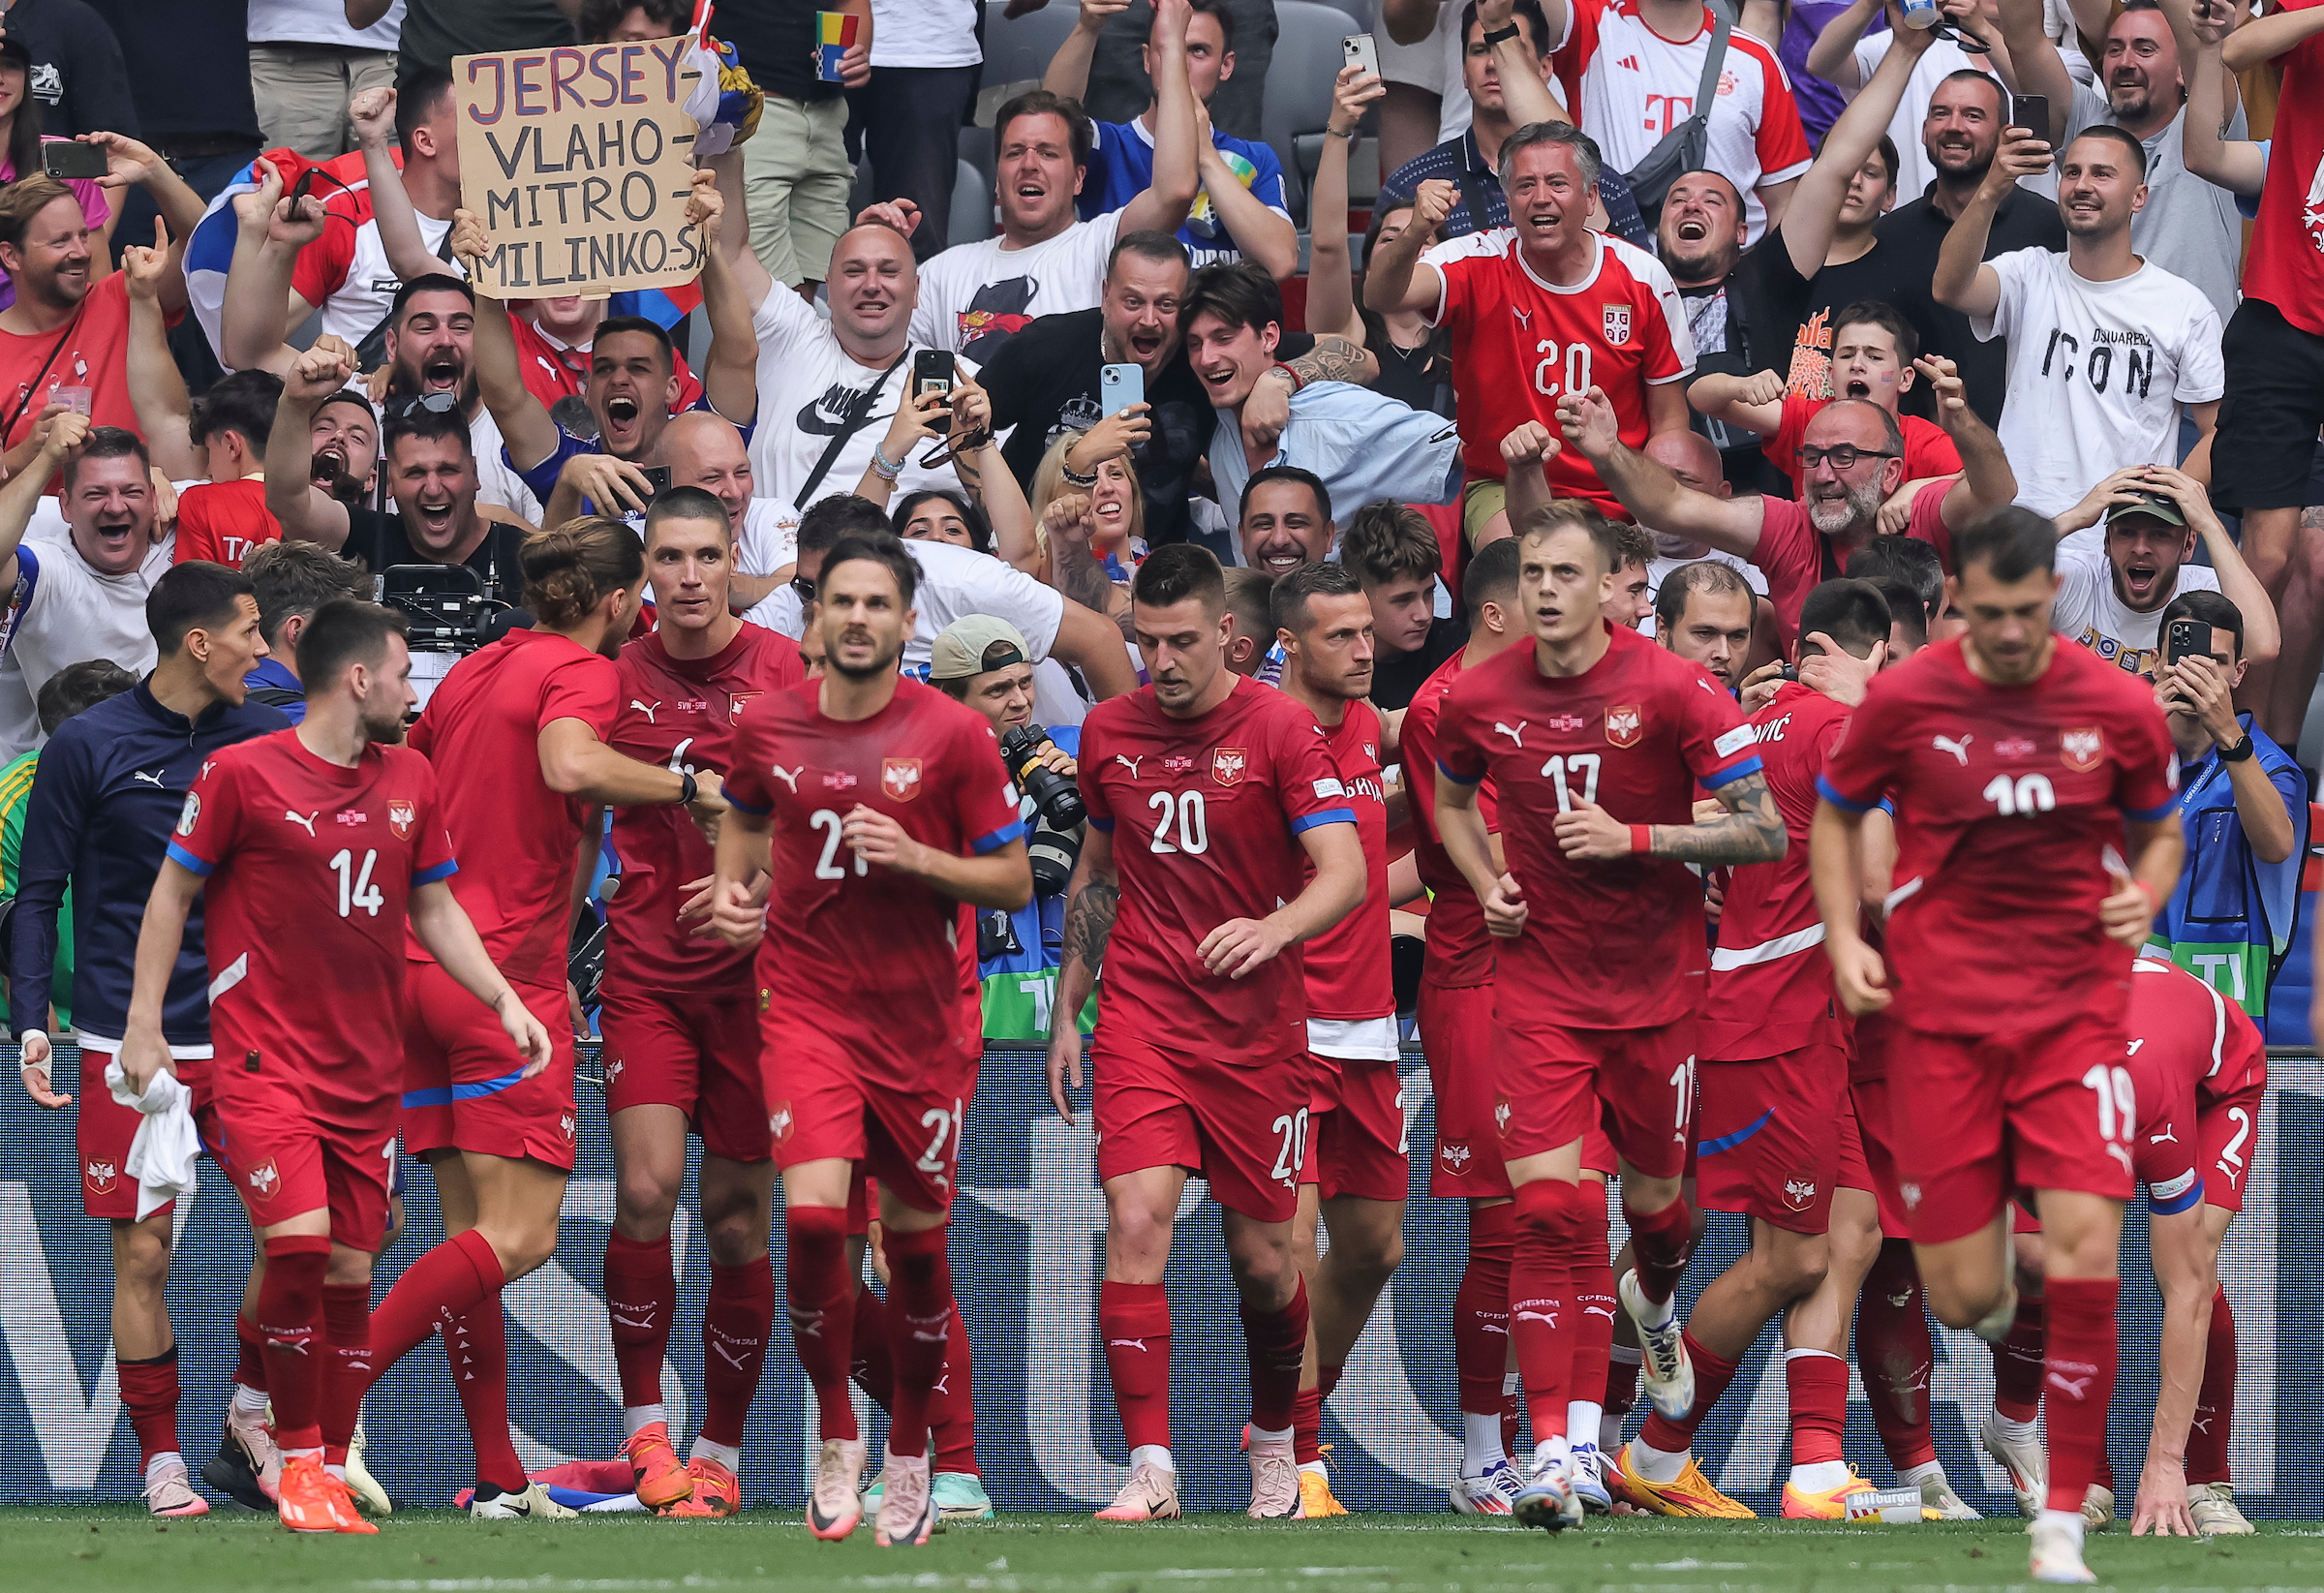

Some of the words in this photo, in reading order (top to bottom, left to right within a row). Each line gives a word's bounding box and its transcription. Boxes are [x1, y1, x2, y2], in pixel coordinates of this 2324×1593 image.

[1535, 338, 1592, 398] 20
[1541, 753, 1602, 812] 17
[1148, 789, 1208, 855] 20
[329, 848, 384, 918] 14
[915, 1096, 963, 1173] 21
[2082, 1063, 2136, 1143] 19
[1270, 1107, 1308, 1179] 20
[2220, 1106, 2249, 1168] 2
[1852, 1491, 1917, 1506] Bitburger
